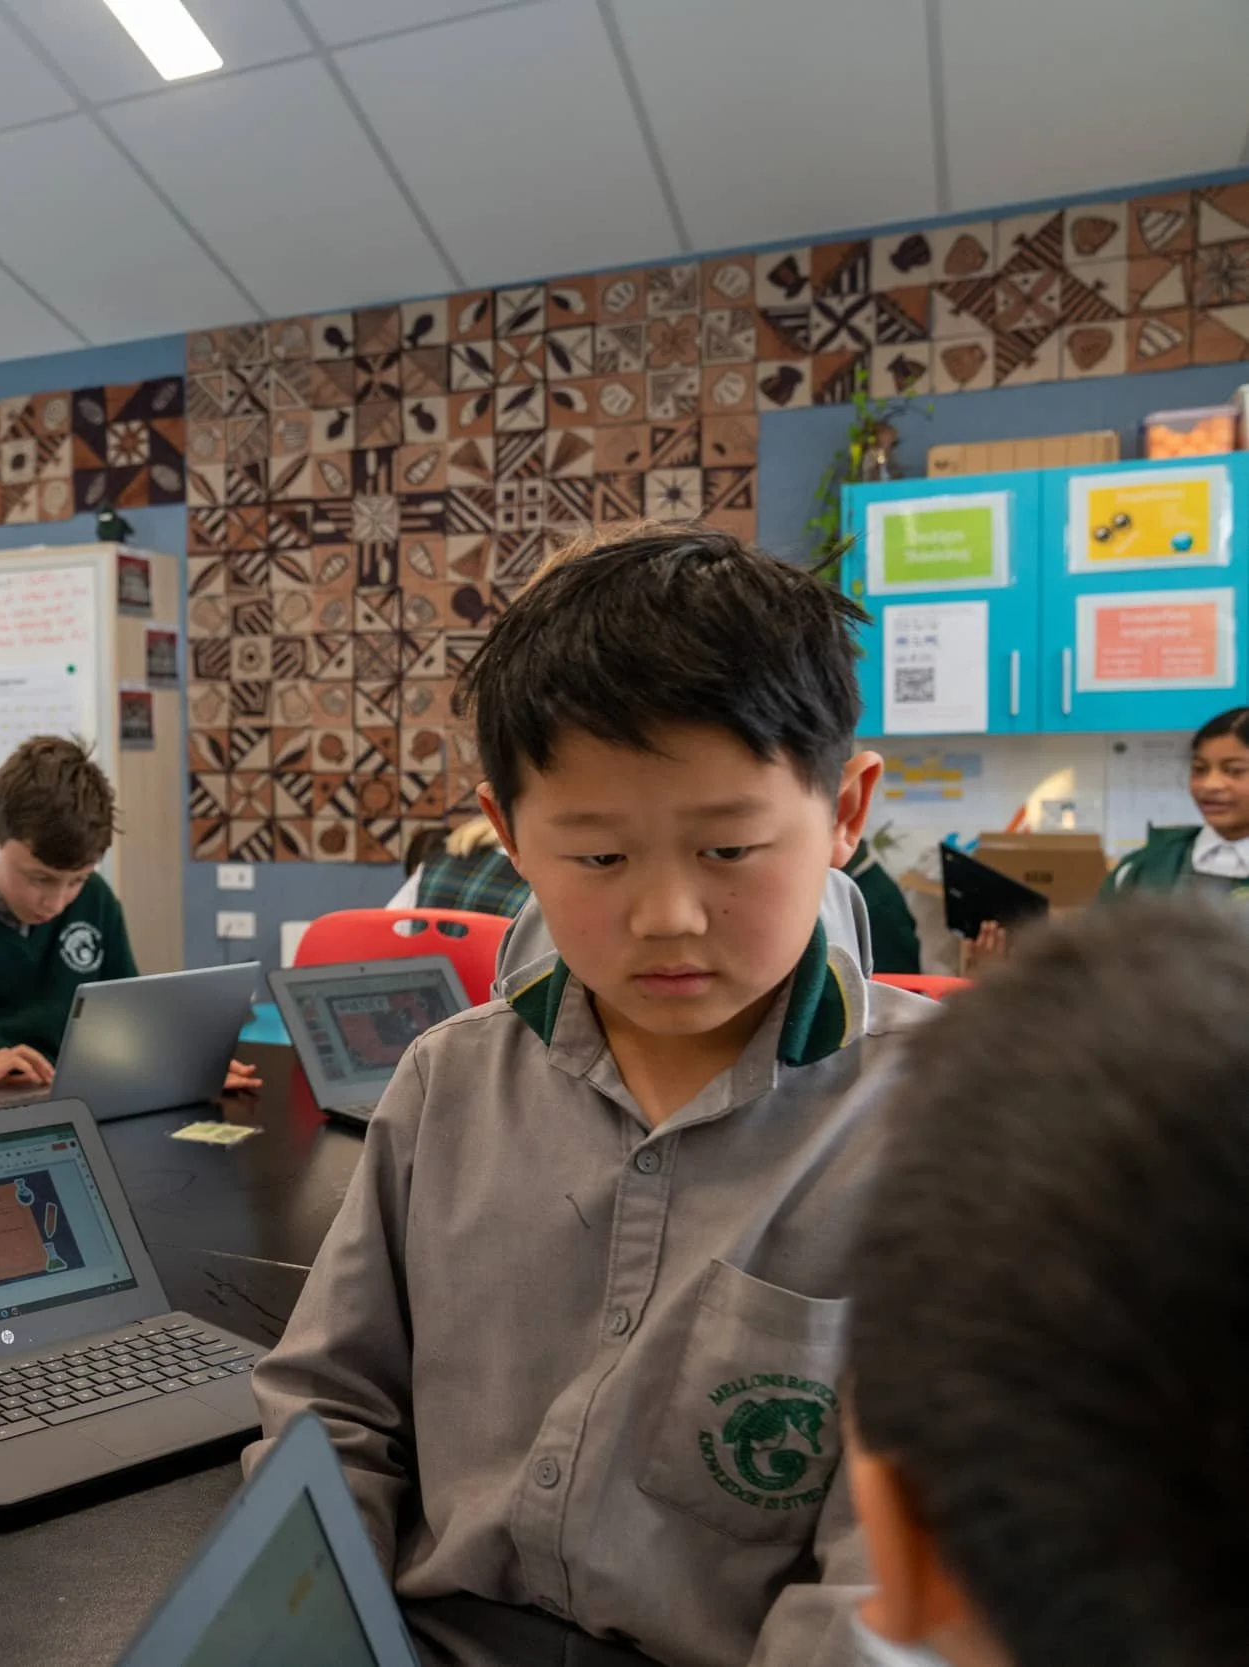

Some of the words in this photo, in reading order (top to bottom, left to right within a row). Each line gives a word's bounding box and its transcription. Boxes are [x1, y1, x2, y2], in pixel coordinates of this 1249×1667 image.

[1, 1330, 15, 1344] hp
[707, 1374, 784, 1407] MELLONS
[699, 1430, 761, 1507] KNOWLEDGE
